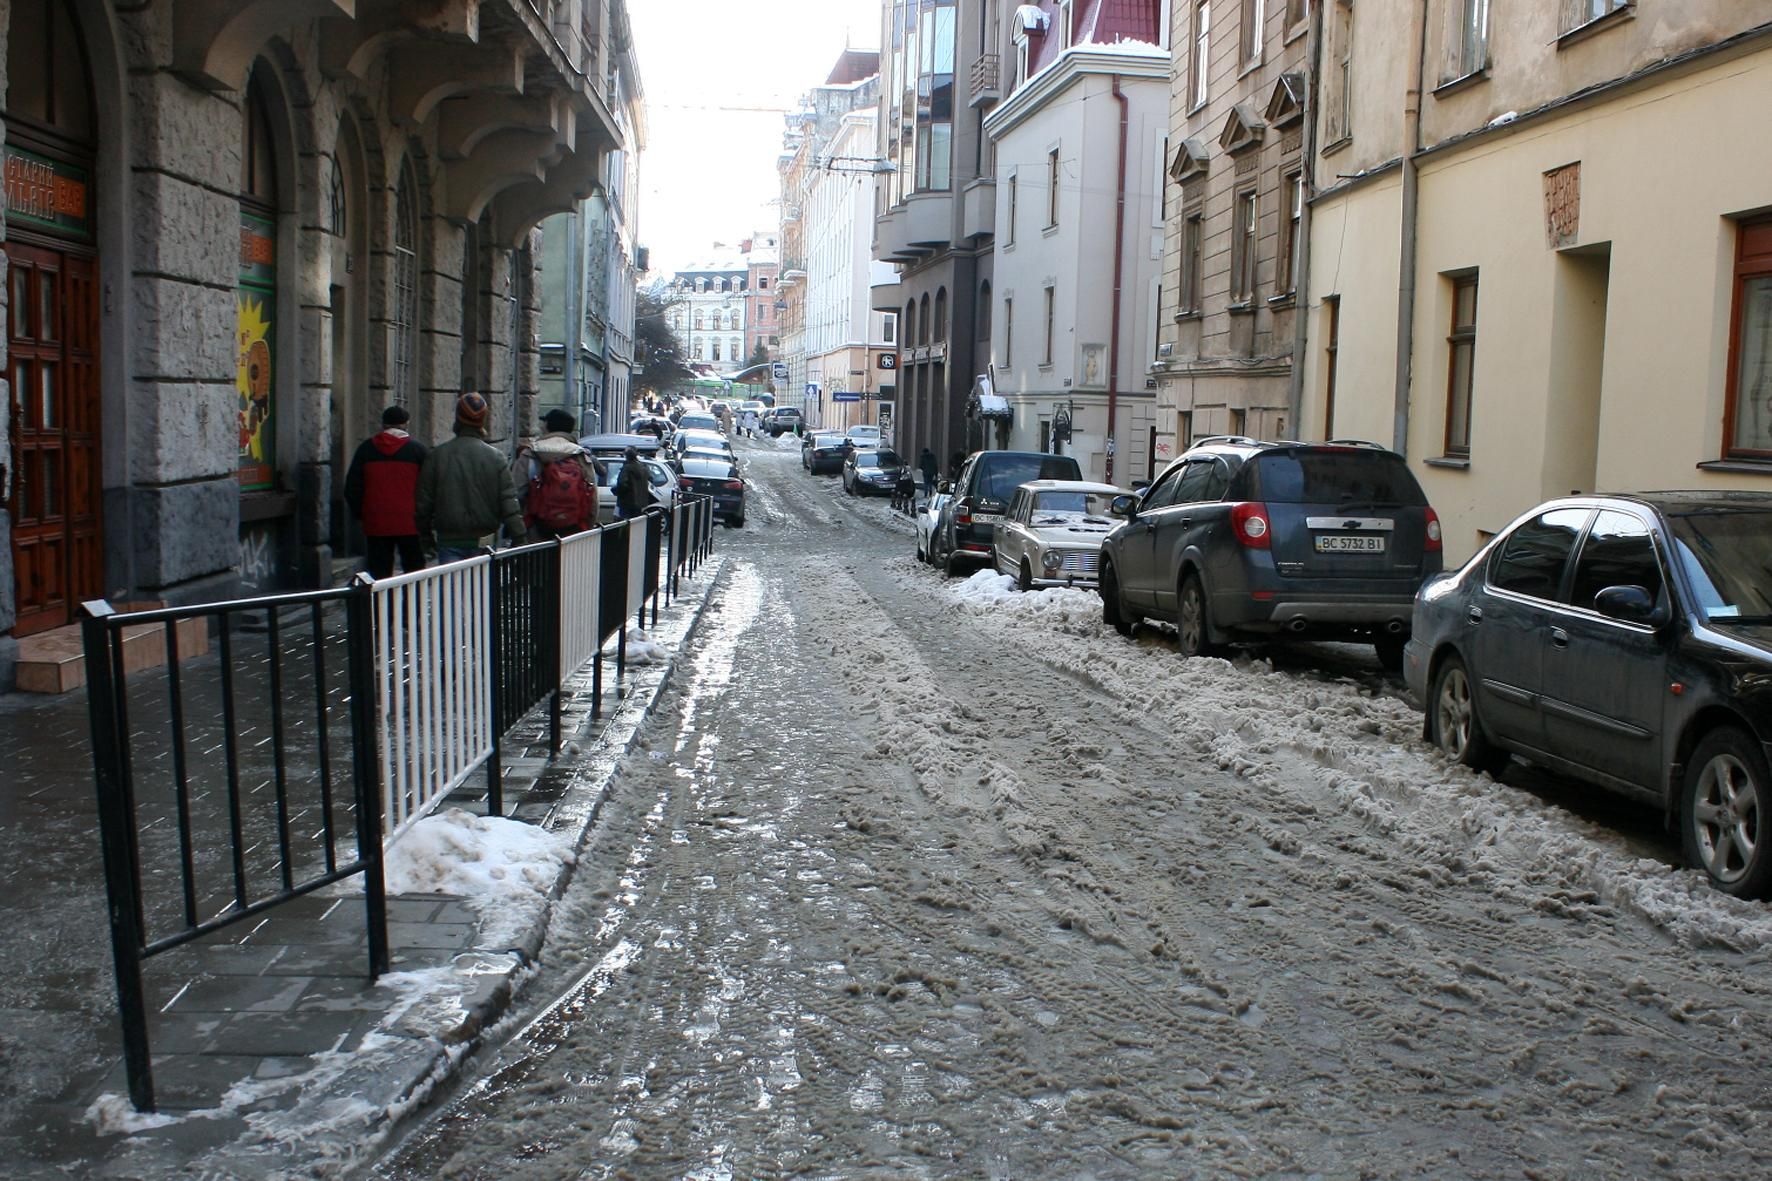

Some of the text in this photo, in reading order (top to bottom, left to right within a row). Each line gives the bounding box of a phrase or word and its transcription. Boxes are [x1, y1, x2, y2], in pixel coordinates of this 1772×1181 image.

[8, 153, 54, 188] СТАРИЙ
[1322, 538, 1380, 549] BC 5732 BI
